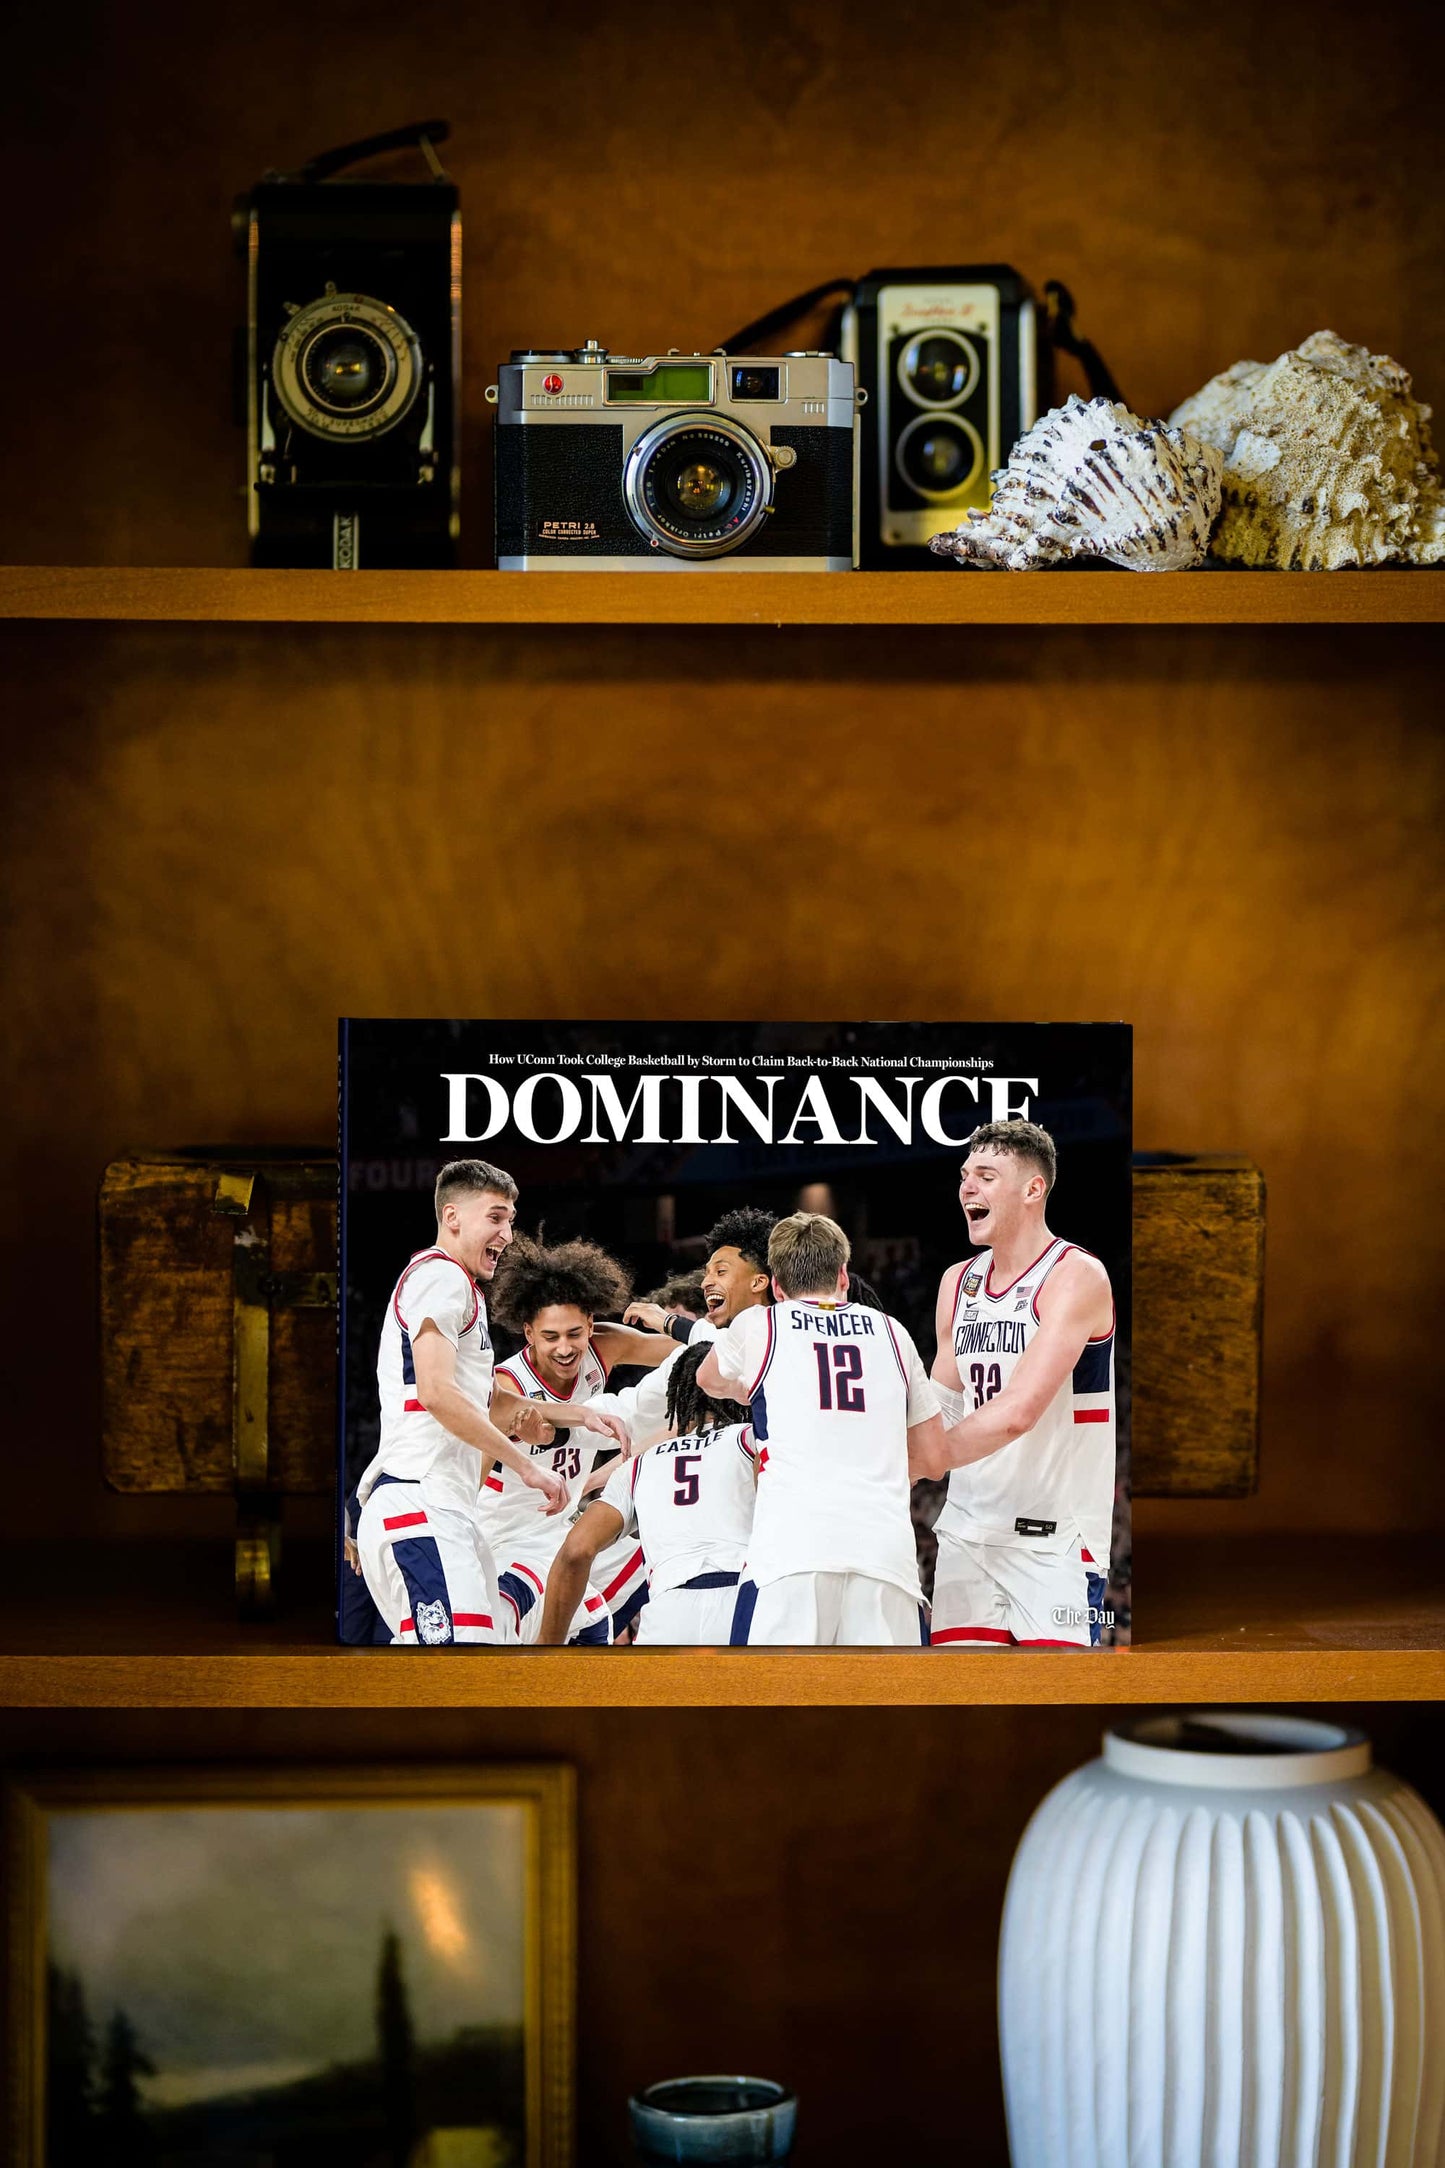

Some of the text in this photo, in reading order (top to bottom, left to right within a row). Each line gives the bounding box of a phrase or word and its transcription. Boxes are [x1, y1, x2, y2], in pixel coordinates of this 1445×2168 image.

[339, 516, 352, 569] KODAK
[543, 521, 595, 530] PETRI 2.8
[489, 1053, 994, 1070] How UConn Took College Basketball by Storm to Claim Back-to-Back National Championships
[439, 1073, 1041, 1146] DOMINANCE
[791, 1310, 875, 1337] SPENCER
[813, 1342, 866, 1413] 12
[970, 1363, 1002, 1410] 32
[656, 1430, 725, 1455] CASTLE
[551, 1447, 581, 1481] 23
[673, 1455, 702, 1506] 5
[1051, 1605, 1116, 1630] The Day
